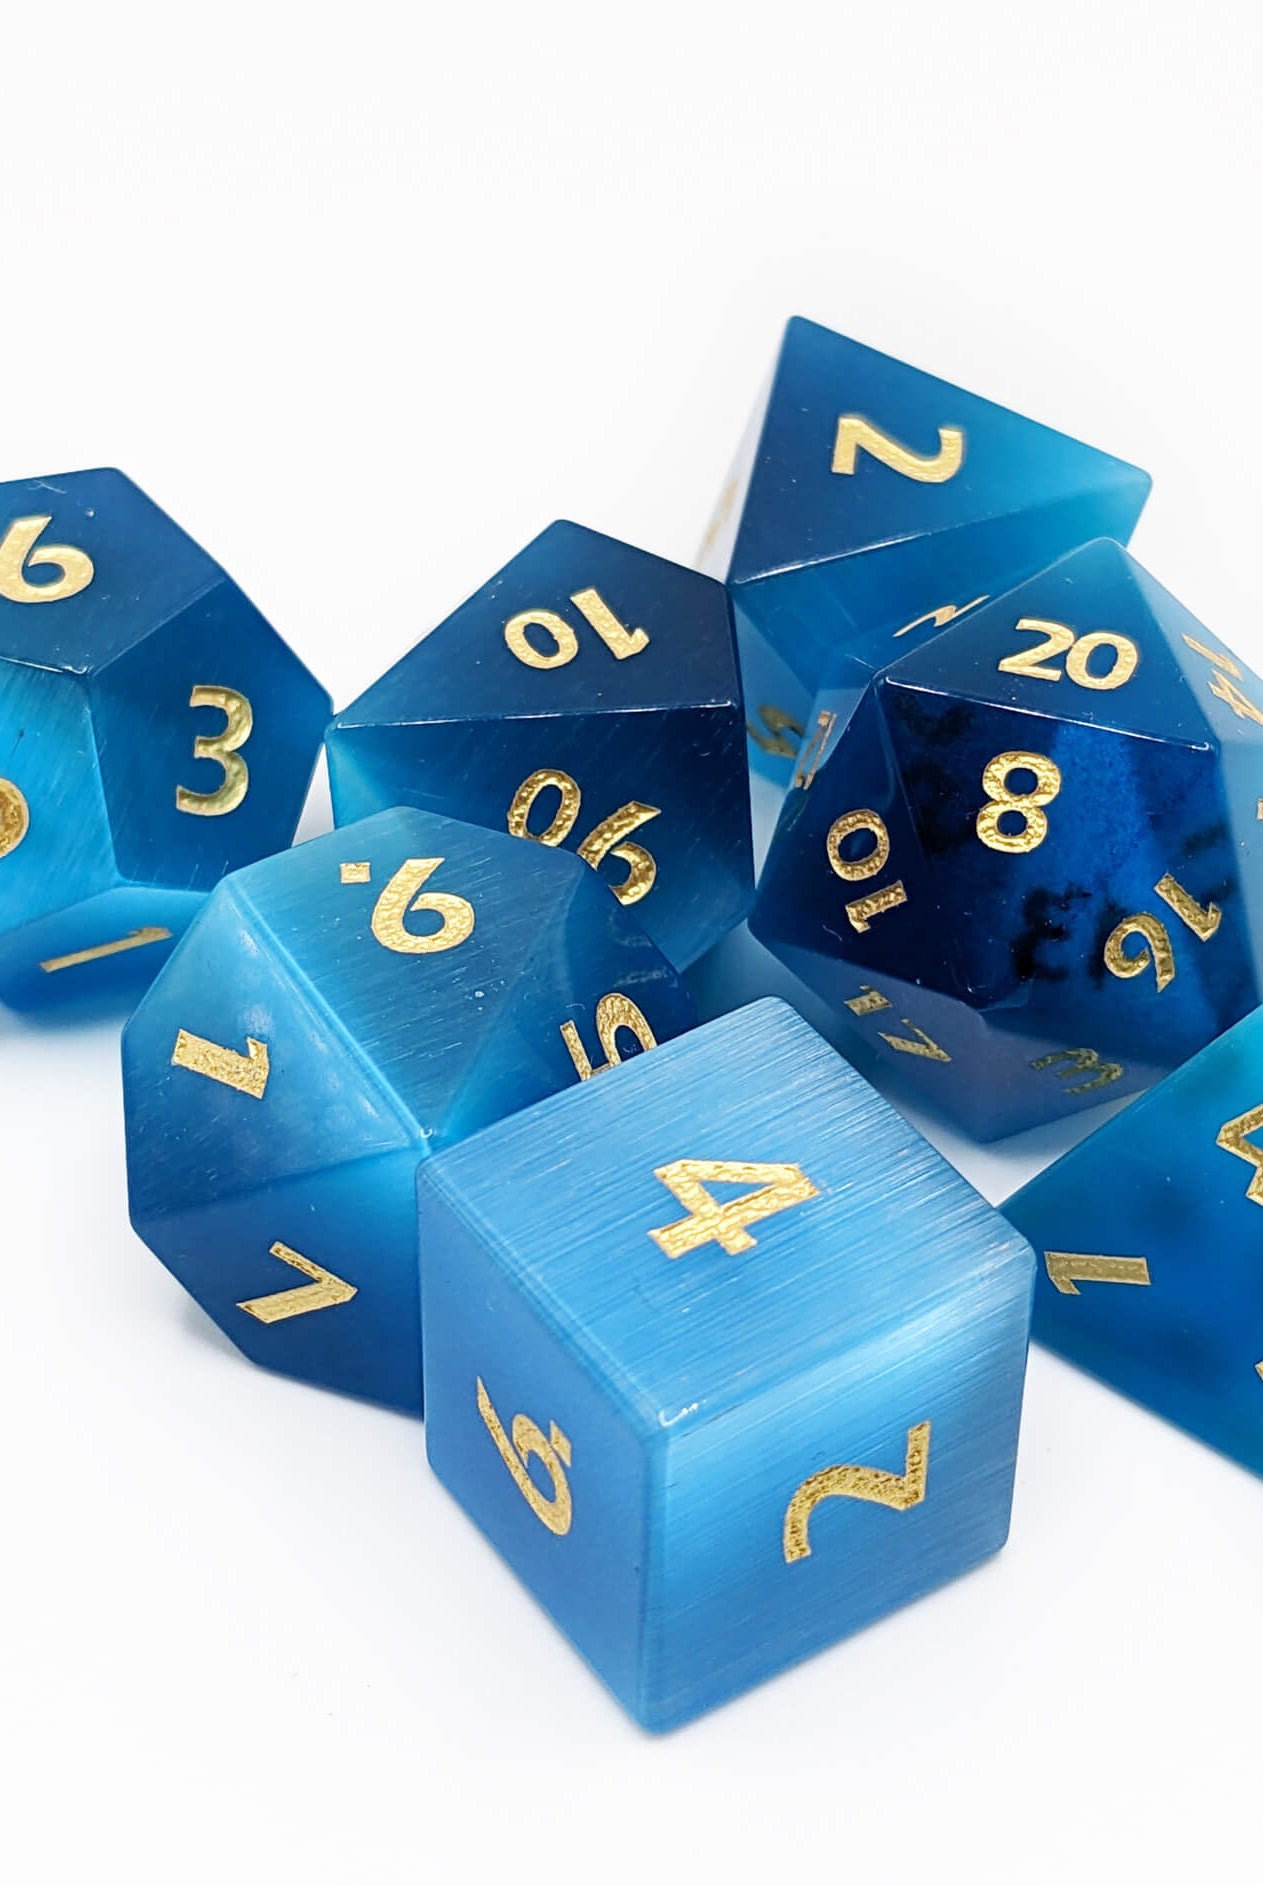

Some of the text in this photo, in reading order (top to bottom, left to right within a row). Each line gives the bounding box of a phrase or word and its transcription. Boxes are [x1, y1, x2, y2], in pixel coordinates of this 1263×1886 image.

[831, 413, 963, 483] 2
[504, 586, 650, 670] 10
[997, 617, 1138, 691] 20
[175, 684, 254, 816] 3
[976, 750, 1062, 854] 8
[826, 808, 908, 934] 10
[39, 926, 173, 973] 1
[1104, 872, 1222, 993] 16
[172, 1028, 270, 1100] 1
[1030, 1047, 1123, 1095] 3
[646, 1158, 821, 1259] 4
[236, 1240, 358, 1324] 7
[1044, 1251, 1151, 1295] 1
[783, 1420, 932, 1564] 2
